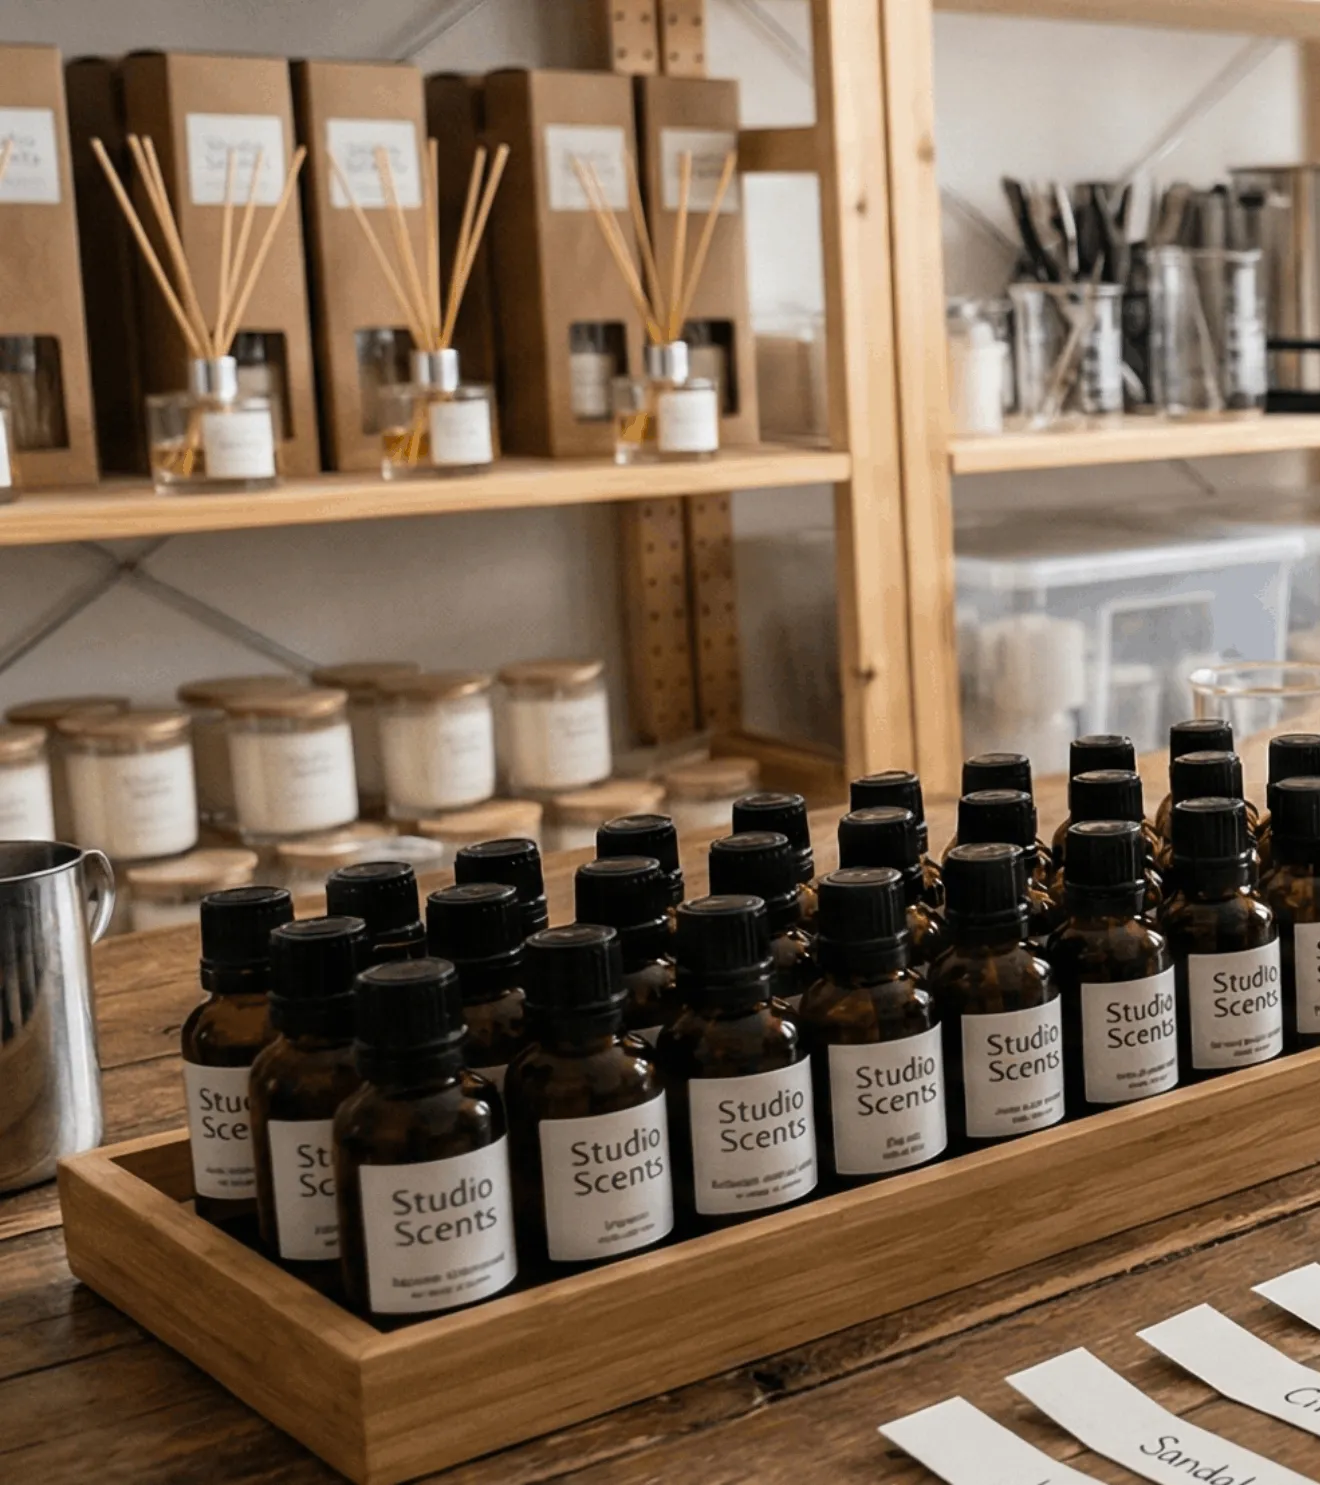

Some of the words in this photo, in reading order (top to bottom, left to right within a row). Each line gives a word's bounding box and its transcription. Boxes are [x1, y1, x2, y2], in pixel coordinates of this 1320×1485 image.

[1213, 965, 1278, 994] Studio
[1106, 993, 1173, 1024] Studio
[1213, 989, 1278, 1018] Scents
[986, 1023, 1059, 1056] Studio
[1107, 1018, 1174, 1049] Scents
[856, 1055, 936, 1089] Studio
[988, 1050, 1060, 1083] Scents
[718, 1089, 804, 1124] Studio
[857, 1082, 937, 1116] Scents
[570, 1128, 661, 1167] Studio
[720, 1117, 806, 1153] Scents
[573, 1156, 664, 1197] Scents
[391, 1176, 493, 1216] Studio
[394, 1206, 498, 1247] Scents
